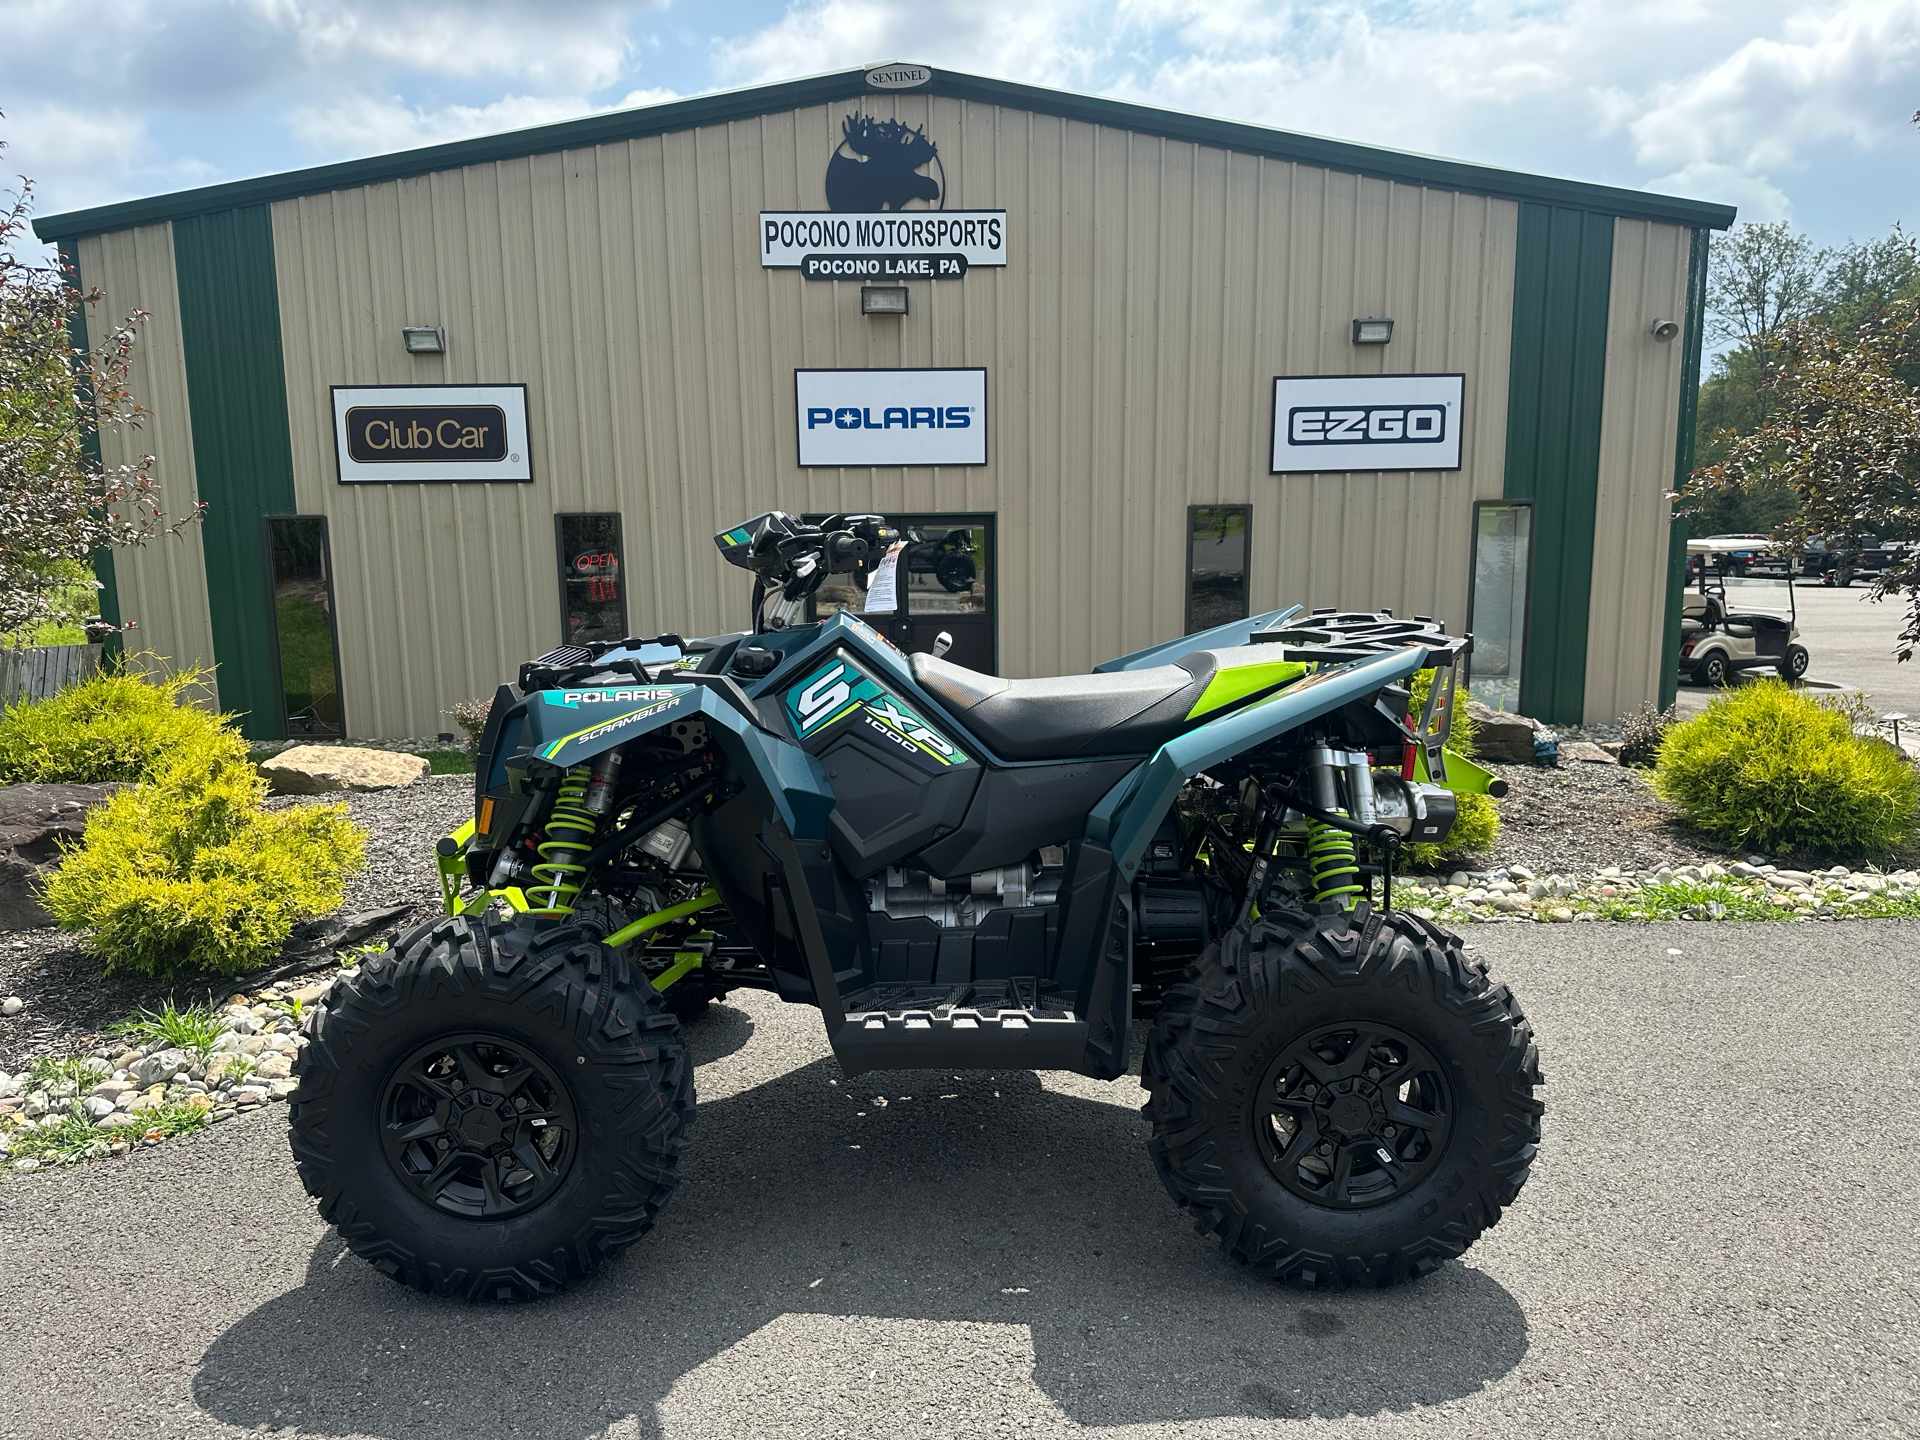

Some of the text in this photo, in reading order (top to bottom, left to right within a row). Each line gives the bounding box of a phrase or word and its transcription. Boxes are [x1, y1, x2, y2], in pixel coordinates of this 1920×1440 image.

[872, 70, 926, 84] SENTINEL
[764, 218, 1001, 254] POCONO MOTORSPORTS
[808, 259, 961, 277] POCONO LAKE, PA
[807, 406, 971, 429] POLARIS
[1291, 409, 1442, 441] EZGO
[365, 419, 489, 450] Club Car
[577, 553, 619, 570] OPEN
[564, 689, 674, 704] POLARIS
[578, 697, 681, 745] SCRAMBLER
[864, 715, 919, 753] 1000
[865, 697, 954, 756] XP
